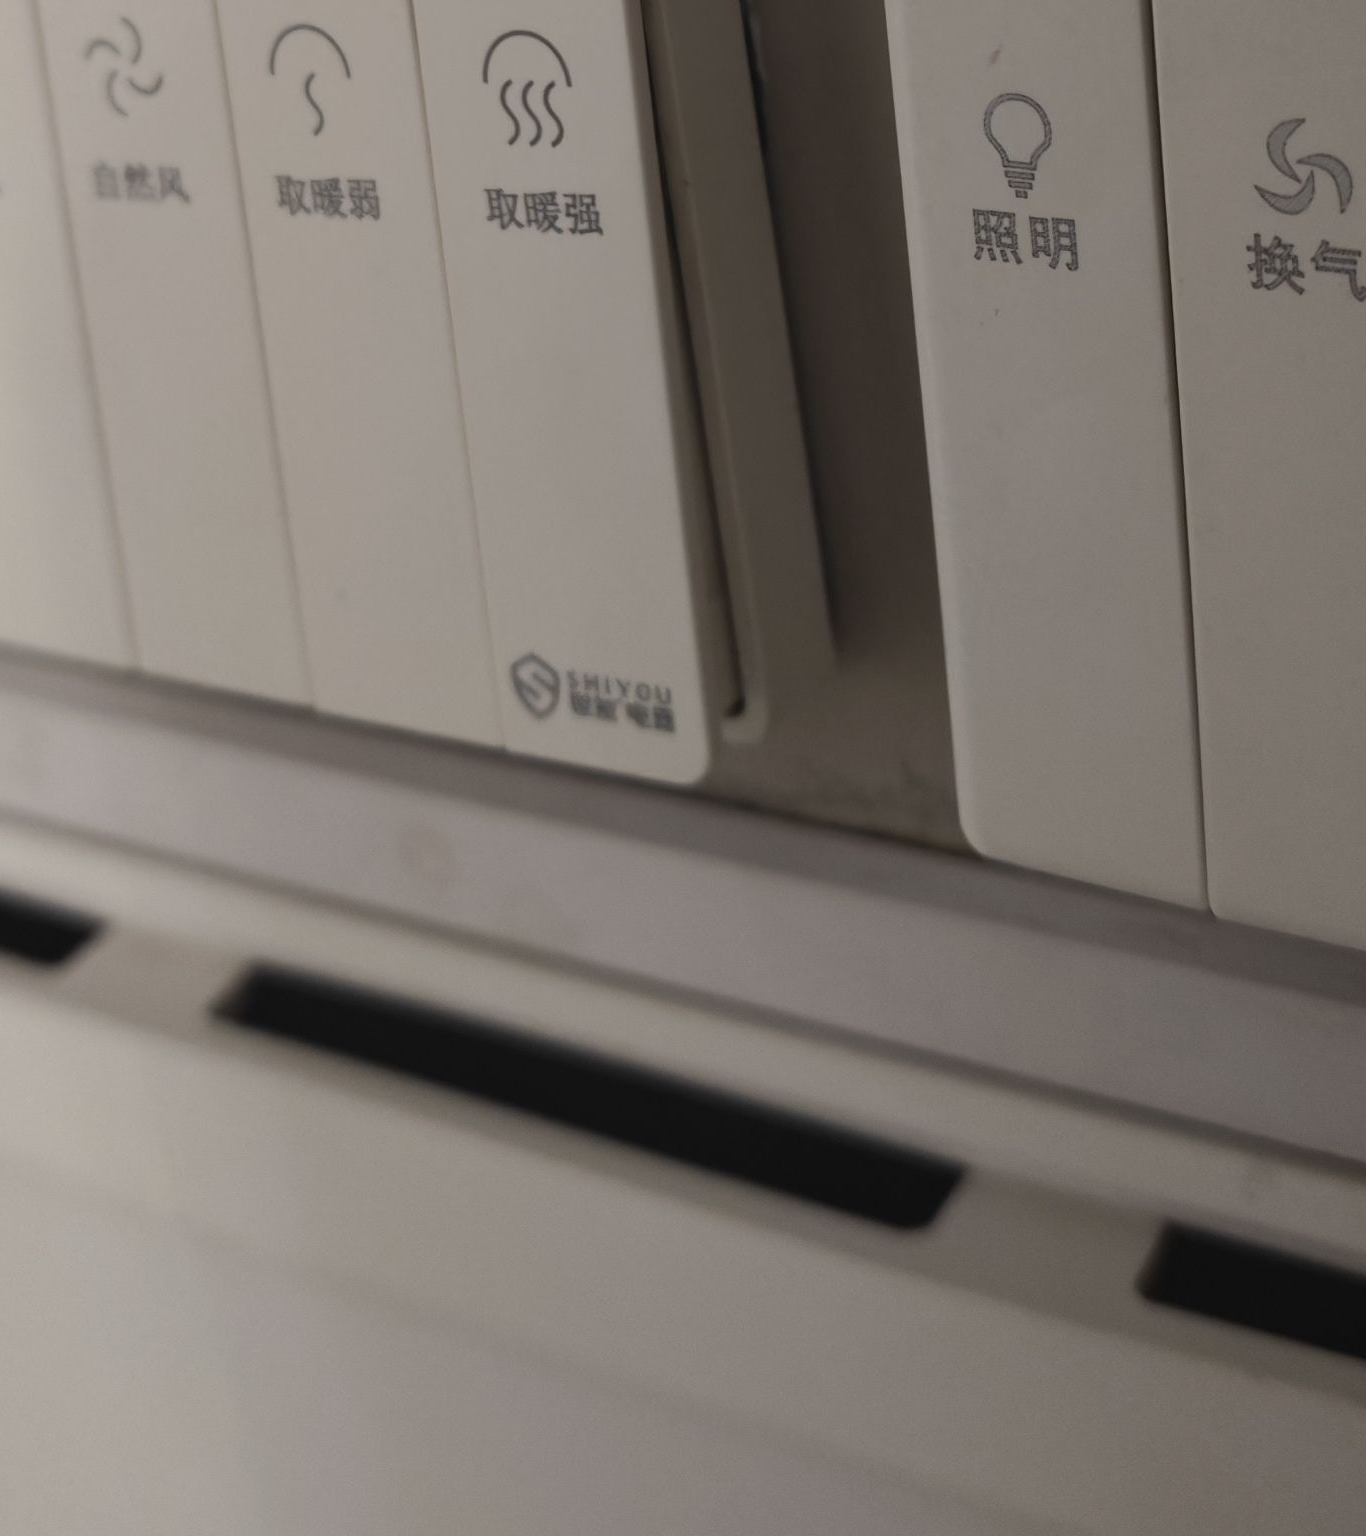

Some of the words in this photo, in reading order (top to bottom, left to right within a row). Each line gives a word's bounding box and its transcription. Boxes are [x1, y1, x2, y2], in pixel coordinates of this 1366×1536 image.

[93, 160, 191, 204] 自然风
[275, 174, 381, 221] 取暖弱
[483, 187, 604, 236] 取暖强
[971, 207, 1080, 272] 照明
[566, 670, 672, 705] SHIYOU
